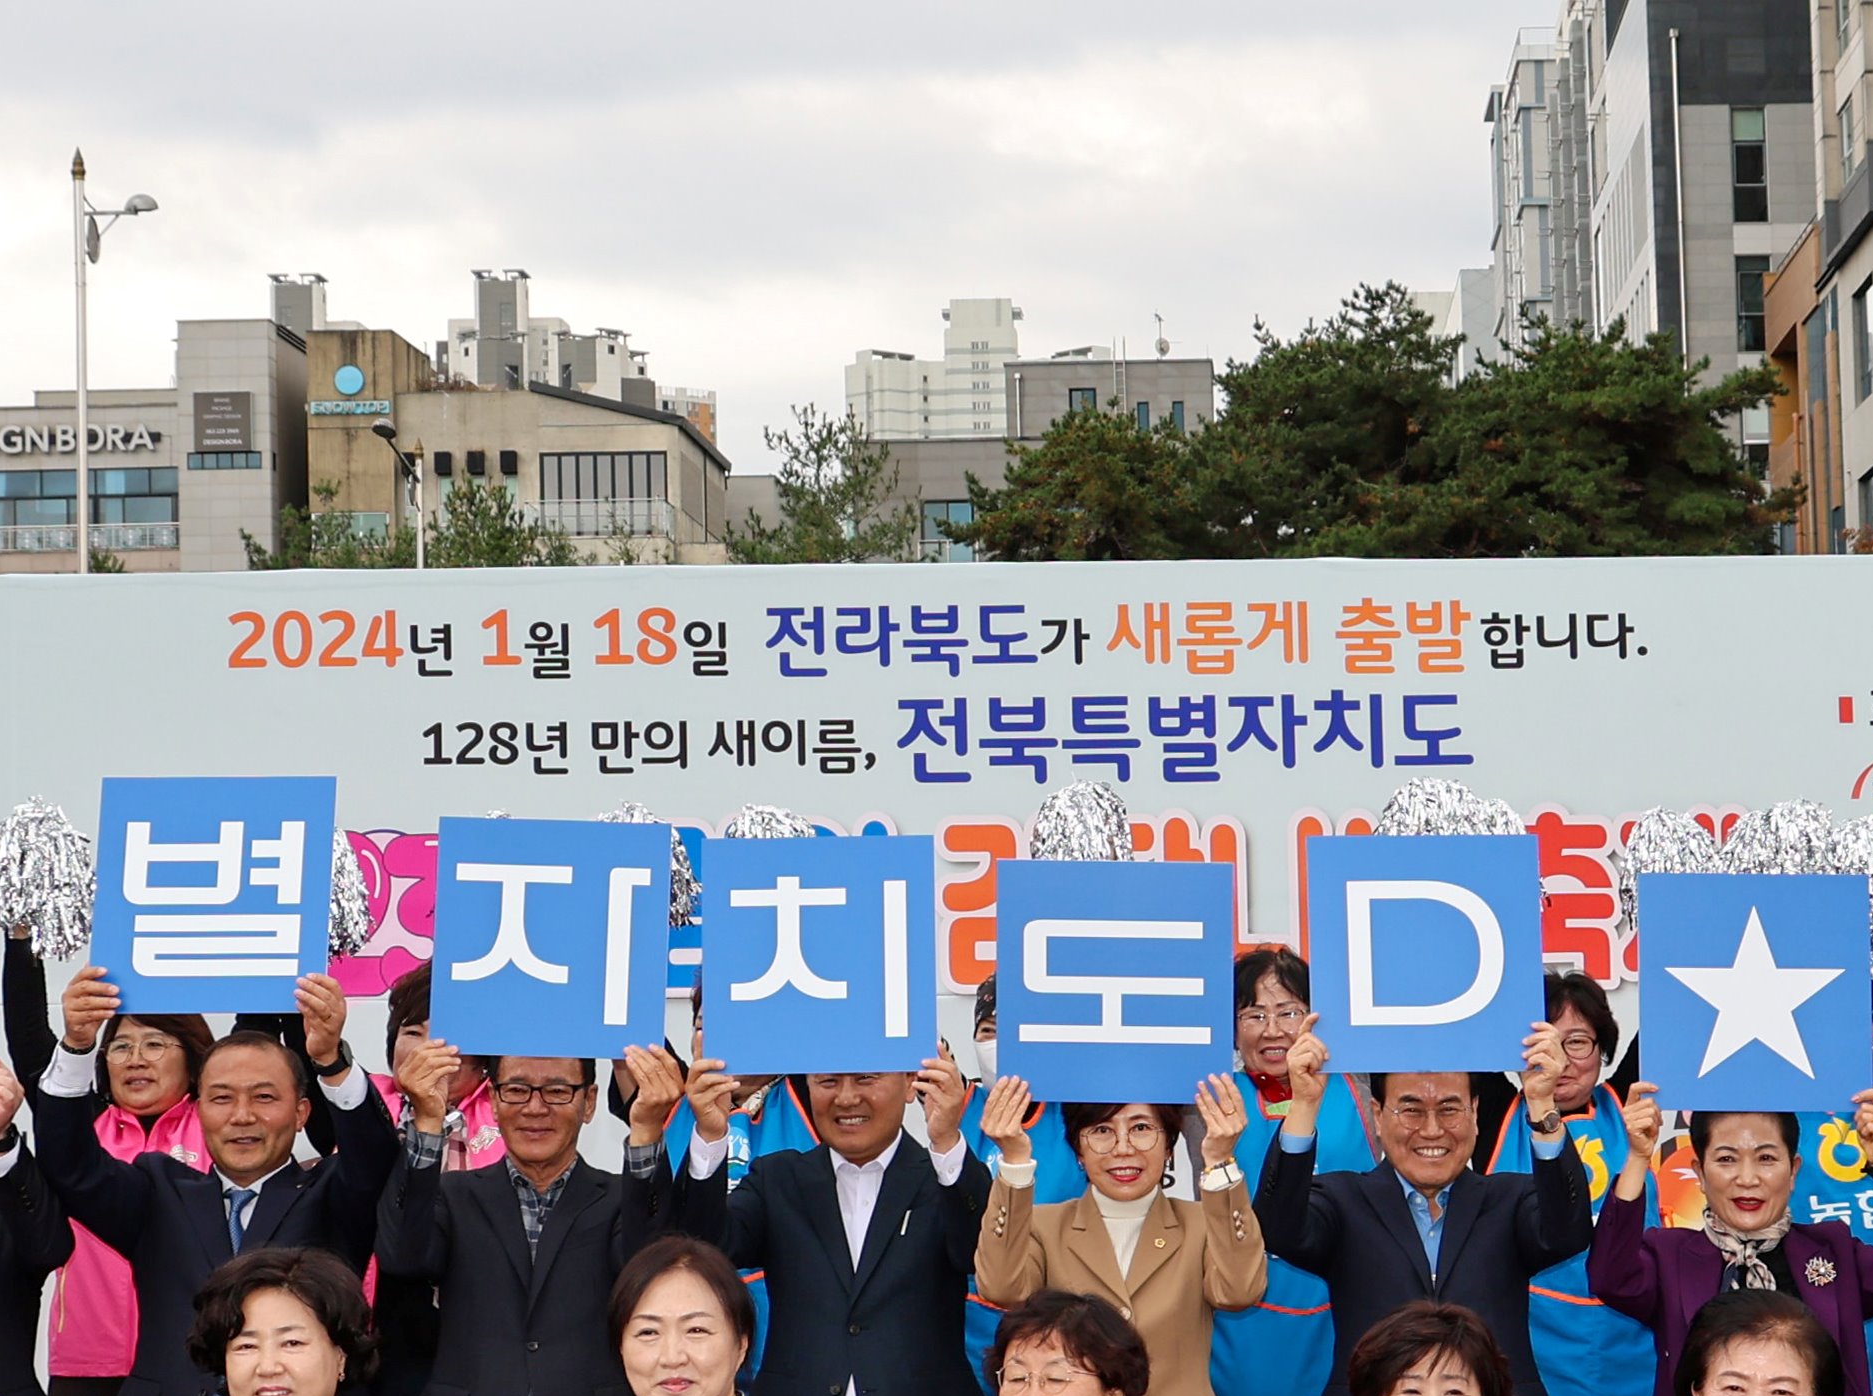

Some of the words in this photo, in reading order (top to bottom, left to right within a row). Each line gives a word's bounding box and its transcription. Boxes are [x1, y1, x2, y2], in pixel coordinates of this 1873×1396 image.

[230, 611, 453, 676] 2024년
[483, 611, 571, 679] 1월
[595, 608, 729, 676] 18일
[766, 605, 1091, 676] 전라북도가
[1108, 602, 1308, 673] 새롭게
[423, 722, 568, 774] 128년
[592, 721, 687, 774] 만의
[708, 720, 876, 773] 새이름,
[898, 691, 1472, 783] 전북특별자치도
[124, 822, 312, 977] 별
[452, 864, 650, 1024] 자
[731, 877, 907, 1037] 치
[1020, 920, 1210, 1044] 도
[1347, 881, 1503, 1025] D
